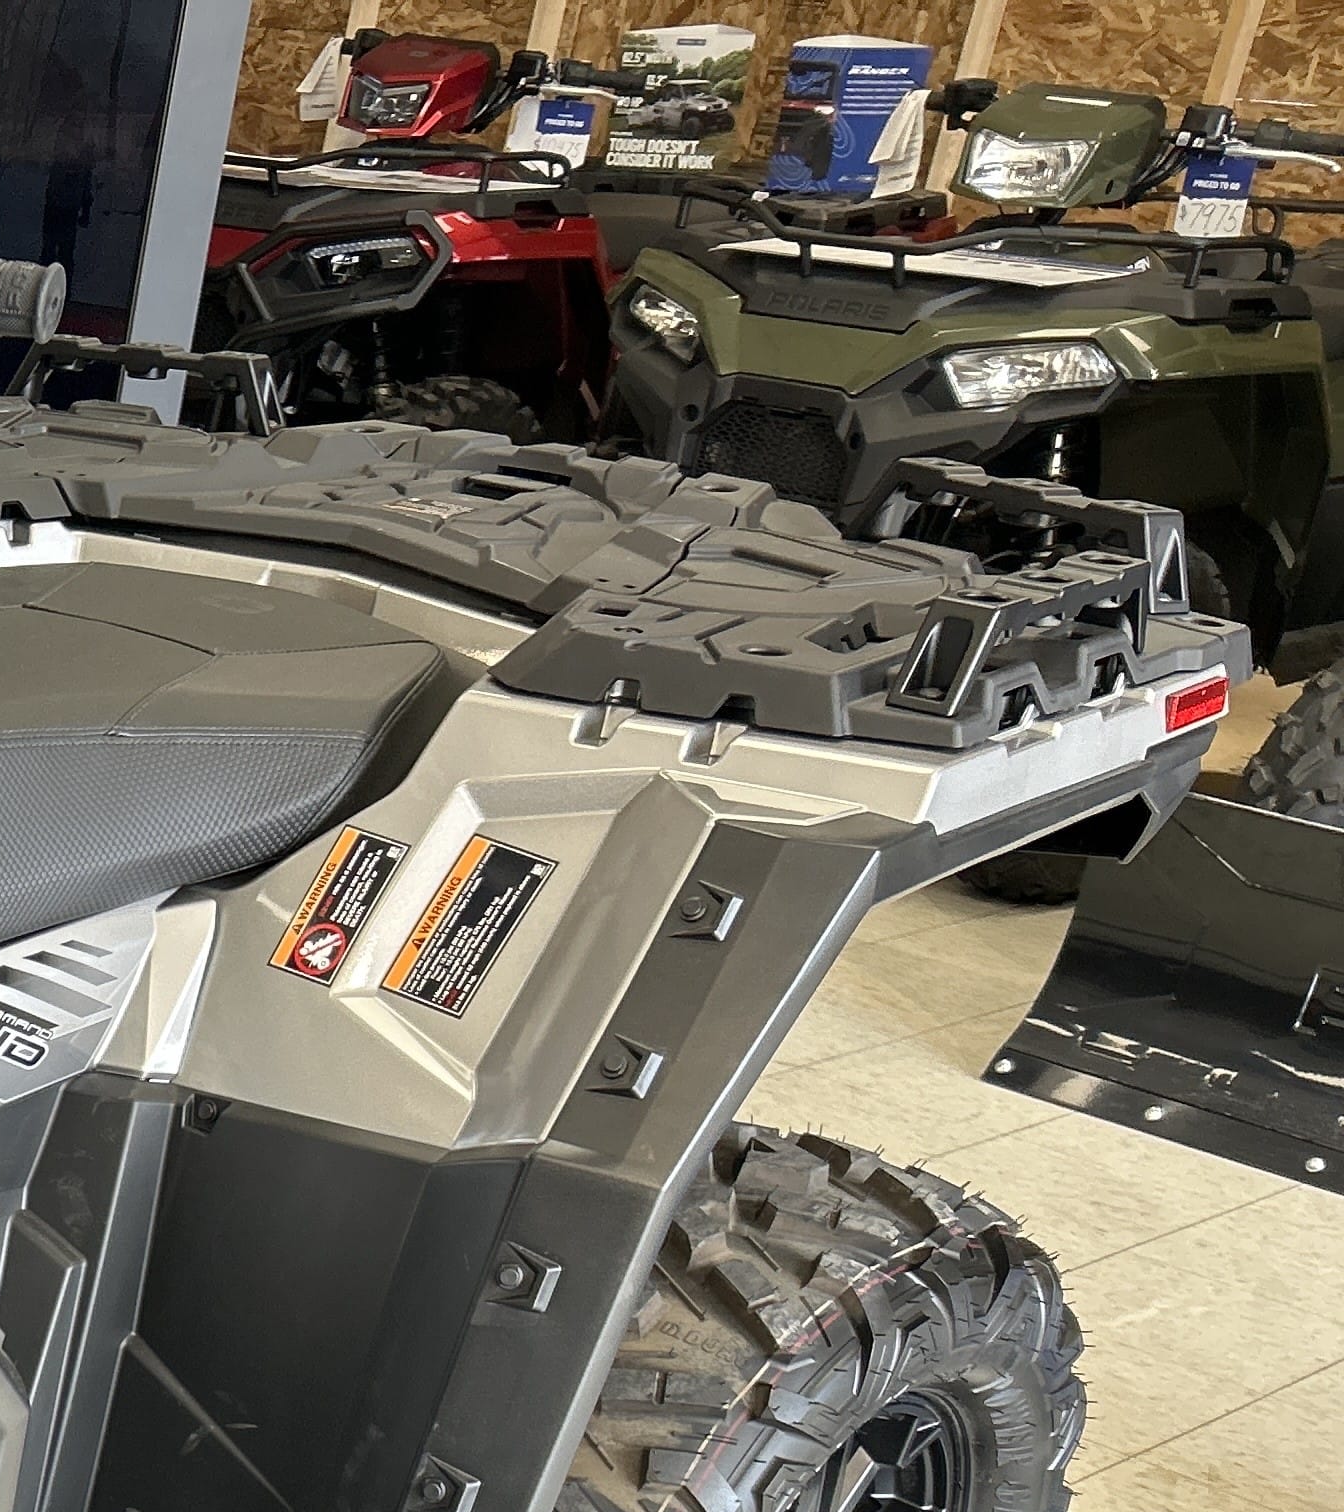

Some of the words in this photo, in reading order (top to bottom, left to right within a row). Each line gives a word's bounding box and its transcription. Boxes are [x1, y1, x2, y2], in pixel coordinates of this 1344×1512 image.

[605, 152, 662, 167] CONSIDER
[662, 154, 678, 168] IT
[677, 155, 716, 170] WORK
[609, 138, 647, 152] TOUGH
[646, 139, 700, 154] DOESN'T
[1192, 179, 1219, 189] PRICED
[1219, 180, 1230, 190] TO
[1178, 202, 1245, 233] $7975
[766, 289, 891, 322] POLARIS
[298, 861, 337, 921] WARNING
[417, 874, 462, 936] WARNING
